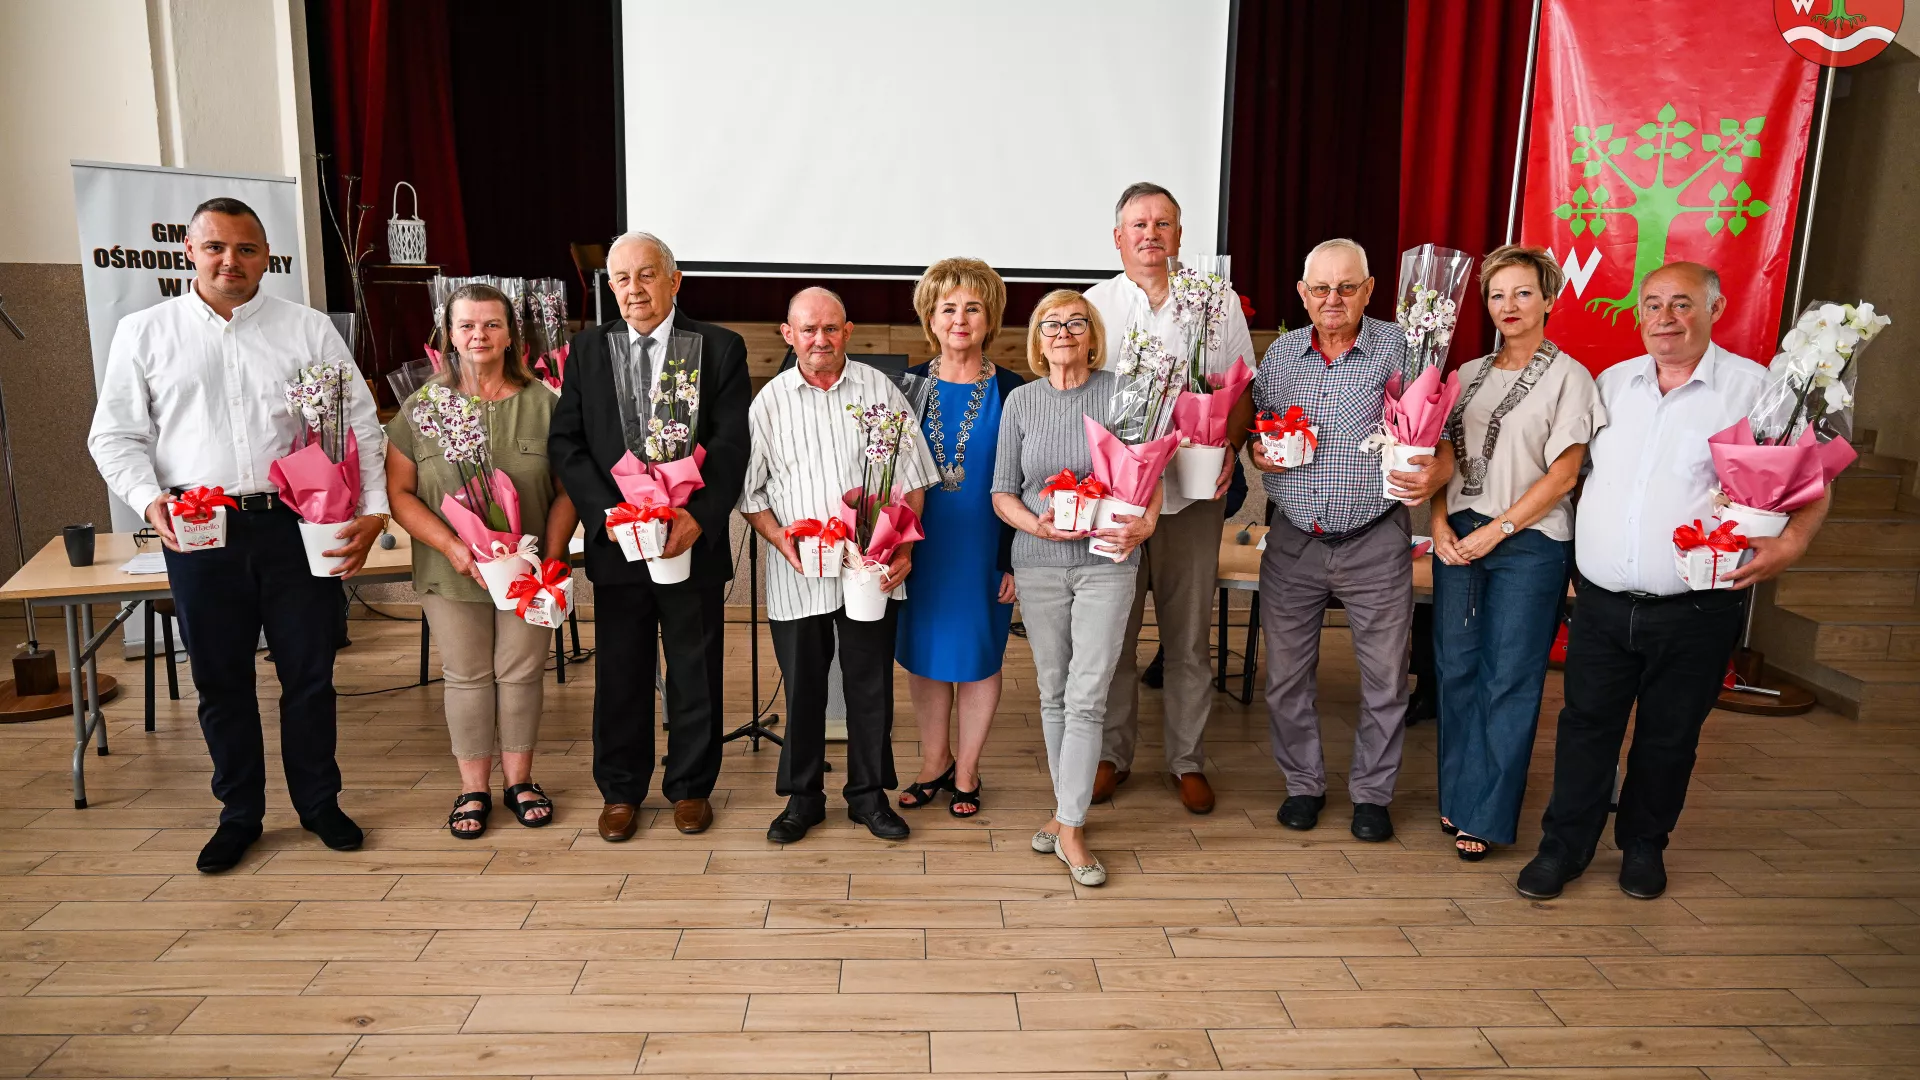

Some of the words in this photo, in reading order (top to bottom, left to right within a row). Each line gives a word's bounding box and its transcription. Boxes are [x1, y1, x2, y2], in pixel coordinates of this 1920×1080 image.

[151, 222, 190, 243] GM
[264, 254, 293, 274] RY
[158, 278, 182, 297] W
[184, 524, 220, 533] Raffaello
